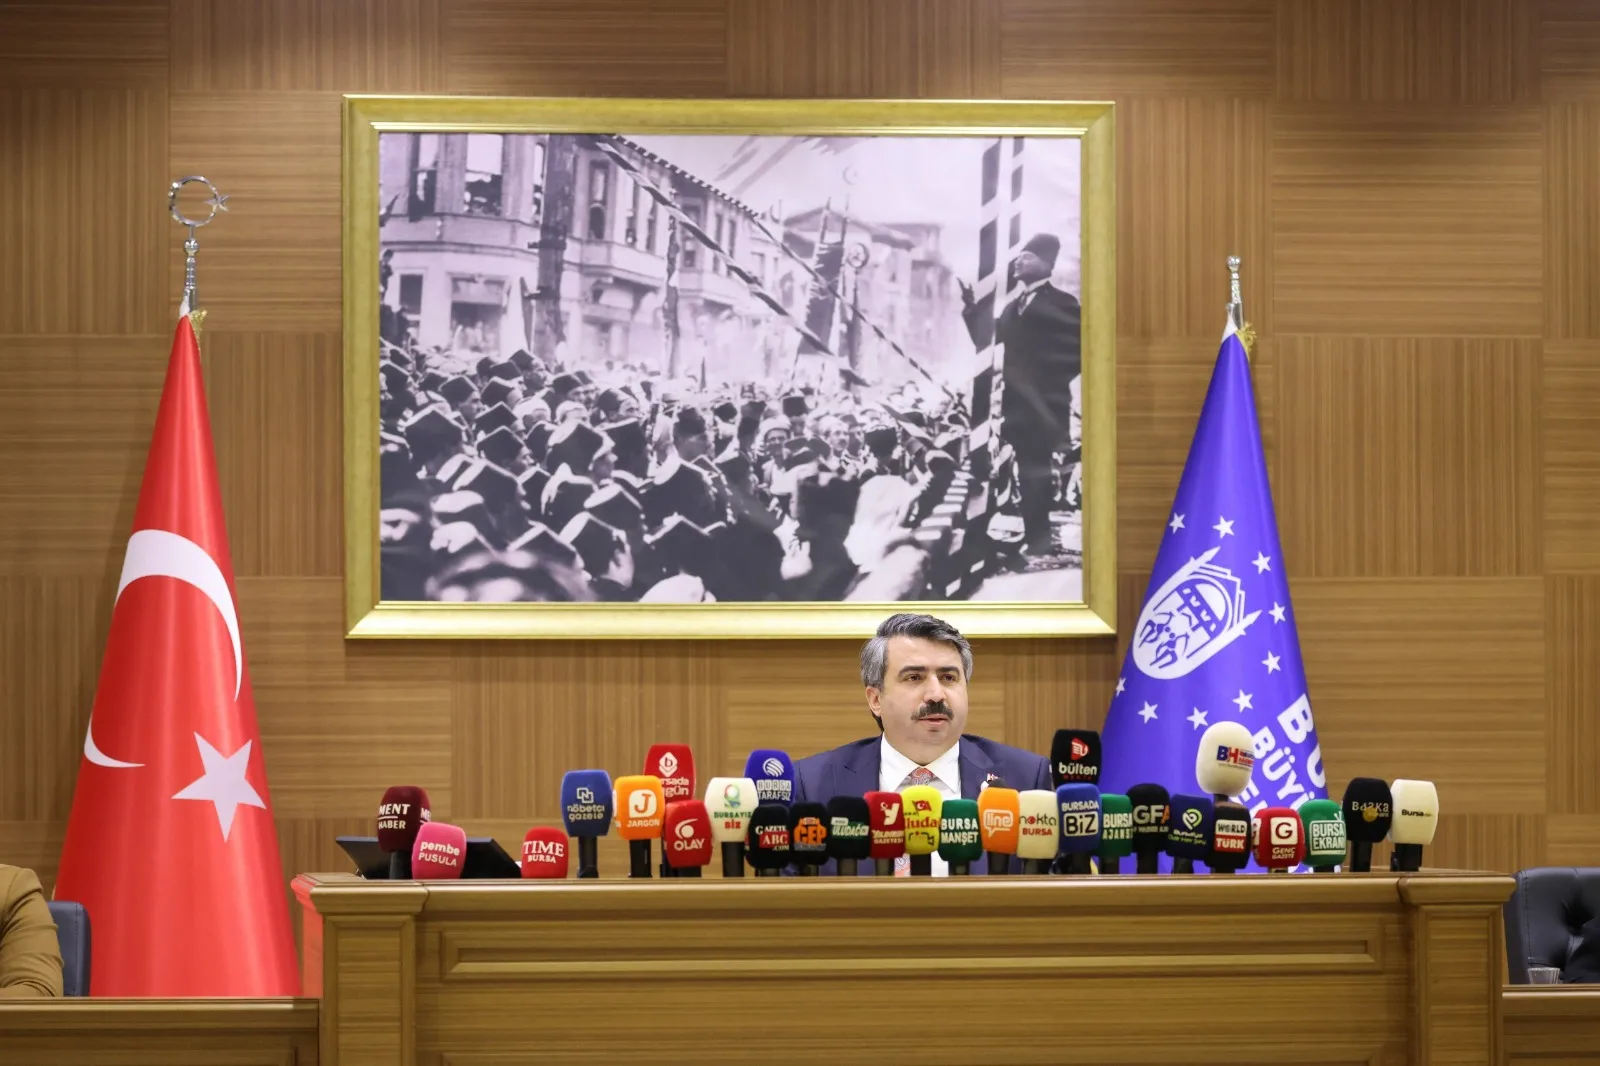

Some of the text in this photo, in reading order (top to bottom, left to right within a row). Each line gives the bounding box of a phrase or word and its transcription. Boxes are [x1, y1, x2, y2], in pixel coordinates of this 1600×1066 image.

[1058, 762, 1098, 776] bülten
[756, 779, 791, 792] BURSA
[378, 803, 411, 816] MENT
[634, 793, 652, 814] J
[1061, 800, 1100, 812] BURSADA
[1401, 808, 1424, 817] Bursa
[378, 820, 406, 829] HABER
[627, 819, 660, 828] JARGON
[941, 818, 979, 831] BURSA
[1018, 813, 1057, 827] nokta
[1022, 827, 1052, 836] BURSA
[1217, 823, 1247, 834] WORLD
[1275, 822, 1293, 840] G
[1312, 823, 1344, 838] BURSA
[674, 838, 705, 851] OLAY
[763, 834, 789, 845] ABC
[941, 831, 979, 846] MANŞET
[420, 841, 461, 857] pembe
[523, 840, 565, 857] TIME
[418, 851, 458, 867] PUSULA
[527, 854, 557, 864] BURSA
